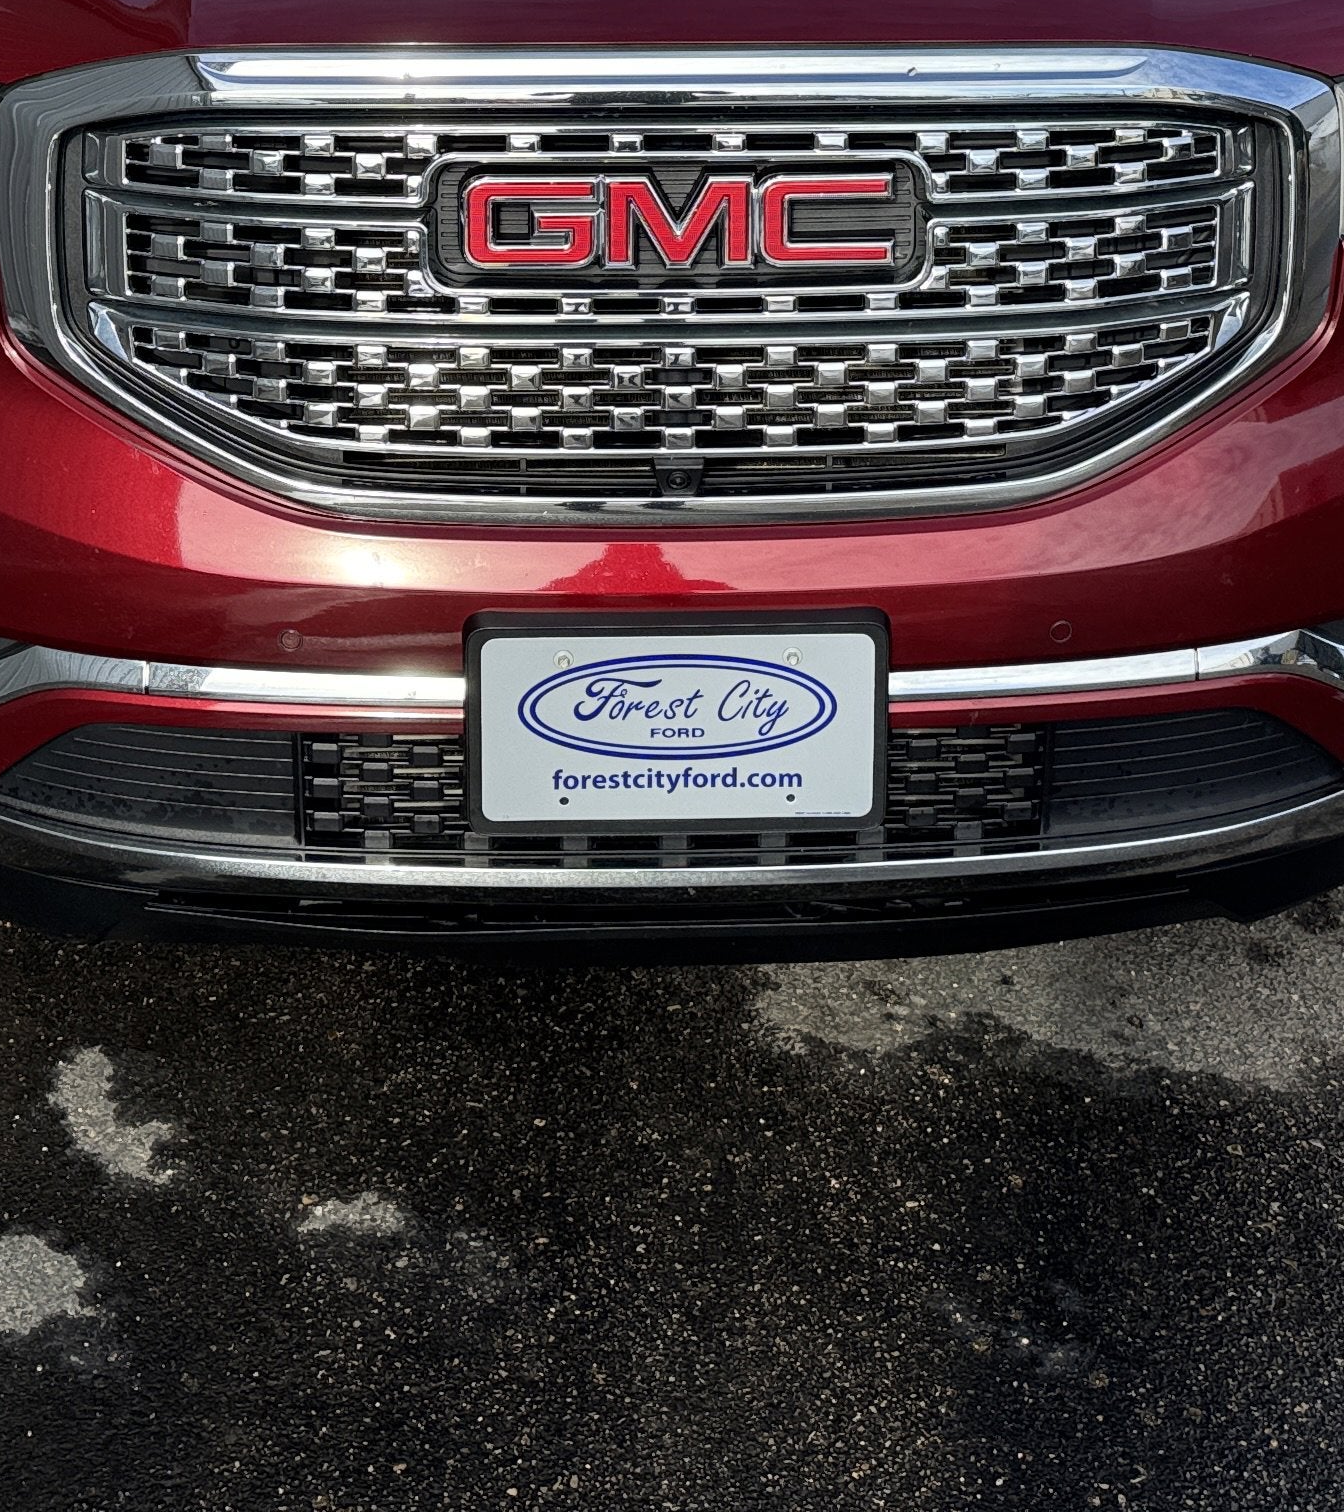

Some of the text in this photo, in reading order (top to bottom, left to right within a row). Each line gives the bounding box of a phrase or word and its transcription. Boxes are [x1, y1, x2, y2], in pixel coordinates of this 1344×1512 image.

[462, 173, 895, 270] GMC
[573, 678, 790, 736] Forest City
[649, 727, 706, 739] FORD
[552, 766, 803, 794] forestcityford.com
